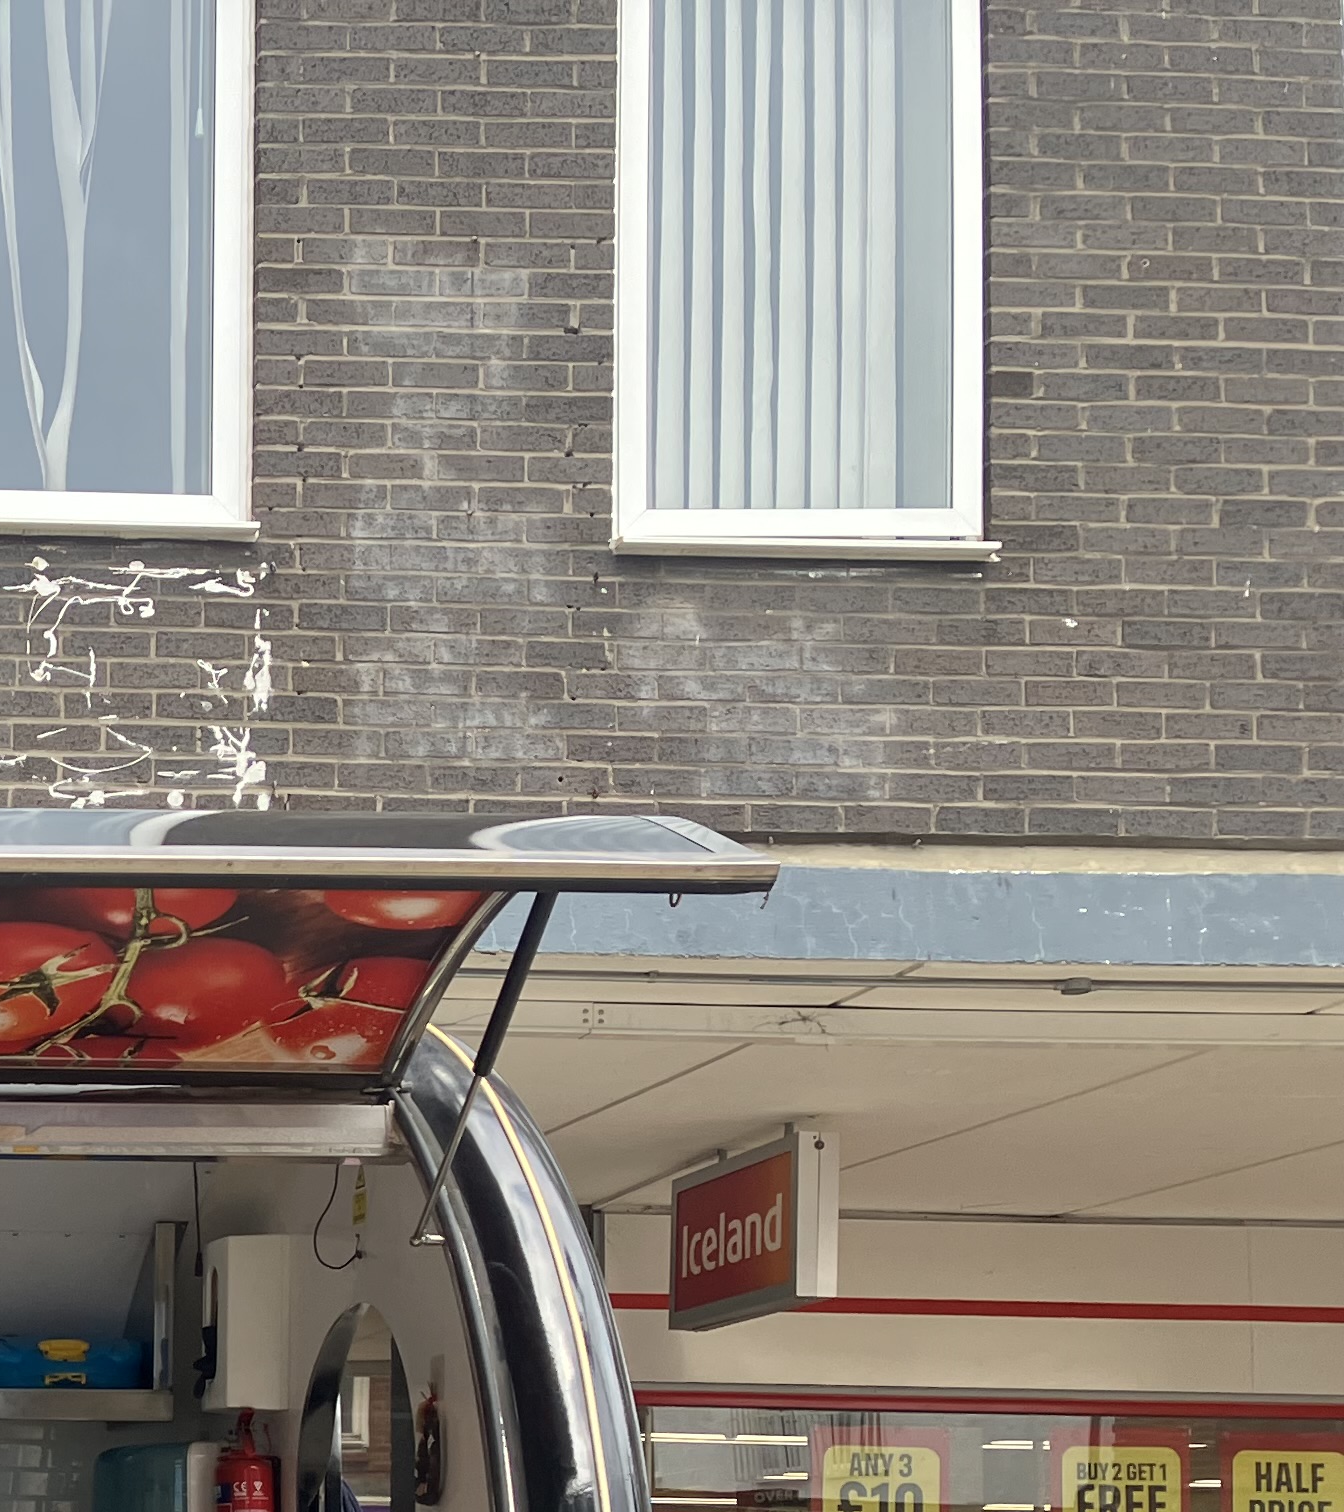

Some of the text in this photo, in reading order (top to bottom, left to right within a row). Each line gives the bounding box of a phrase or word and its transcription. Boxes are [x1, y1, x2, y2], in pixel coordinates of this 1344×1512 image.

[682, 1192, 783, 1278] Iceland
[849, 1452, 913, 1477] ANY 3
[1077, 1462, 1167, 1481] BUY 2 GET 1
[1255, 1461, 1325, 1493] HALF
